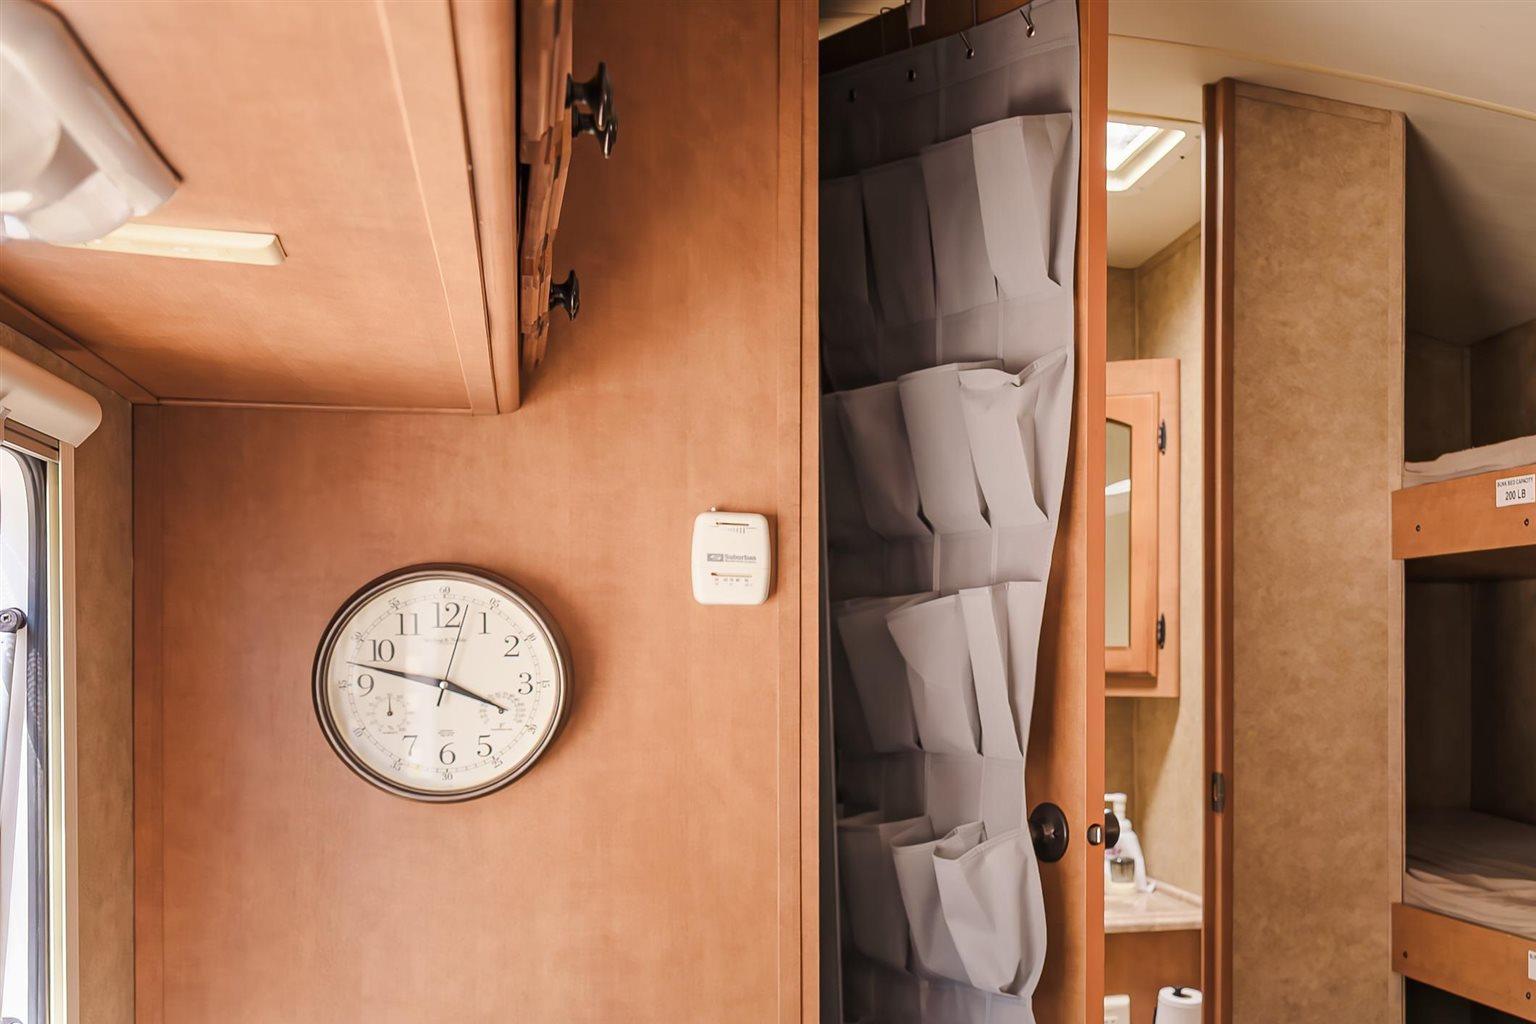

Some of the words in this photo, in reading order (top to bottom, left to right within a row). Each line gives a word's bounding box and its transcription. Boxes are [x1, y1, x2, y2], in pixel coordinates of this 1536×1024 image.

[1505, 490, 1516, 501] 200
[1517, 488, 1526, 499] LB
[395, 613, 422, 636] 11
[432, 602, 461, 628] 12
[478, 611, 492, 635] 1
[369, 638, 395, 663] 10
[503, 634, 520, 658] 2
[357, 673, 375, 698] 9
[518, 672, 533, 695] 3
[402, 734, 418, 757] 7
[439, 742, 456, 766] 6
[477, 734, 493, 758] 5
